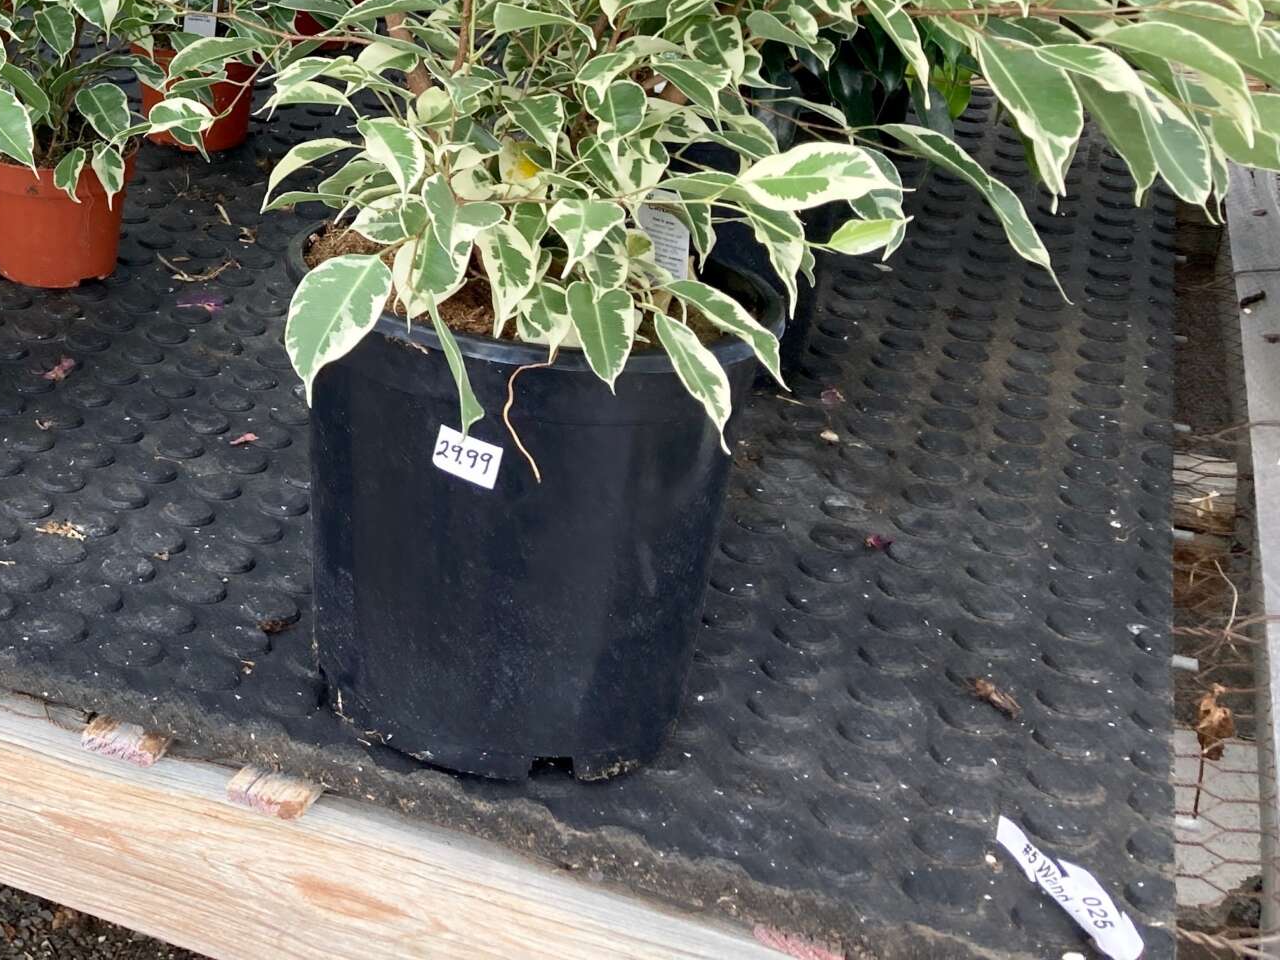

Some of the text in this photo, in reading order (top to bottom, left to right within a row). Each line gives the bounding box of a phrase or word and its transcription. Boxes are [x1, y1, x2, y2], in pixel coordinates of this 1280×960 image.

[435, 440, 494, 475] 29.99
[1022, 843, 1038, 864] #5
[1082, 896, 1115, 929] 025
